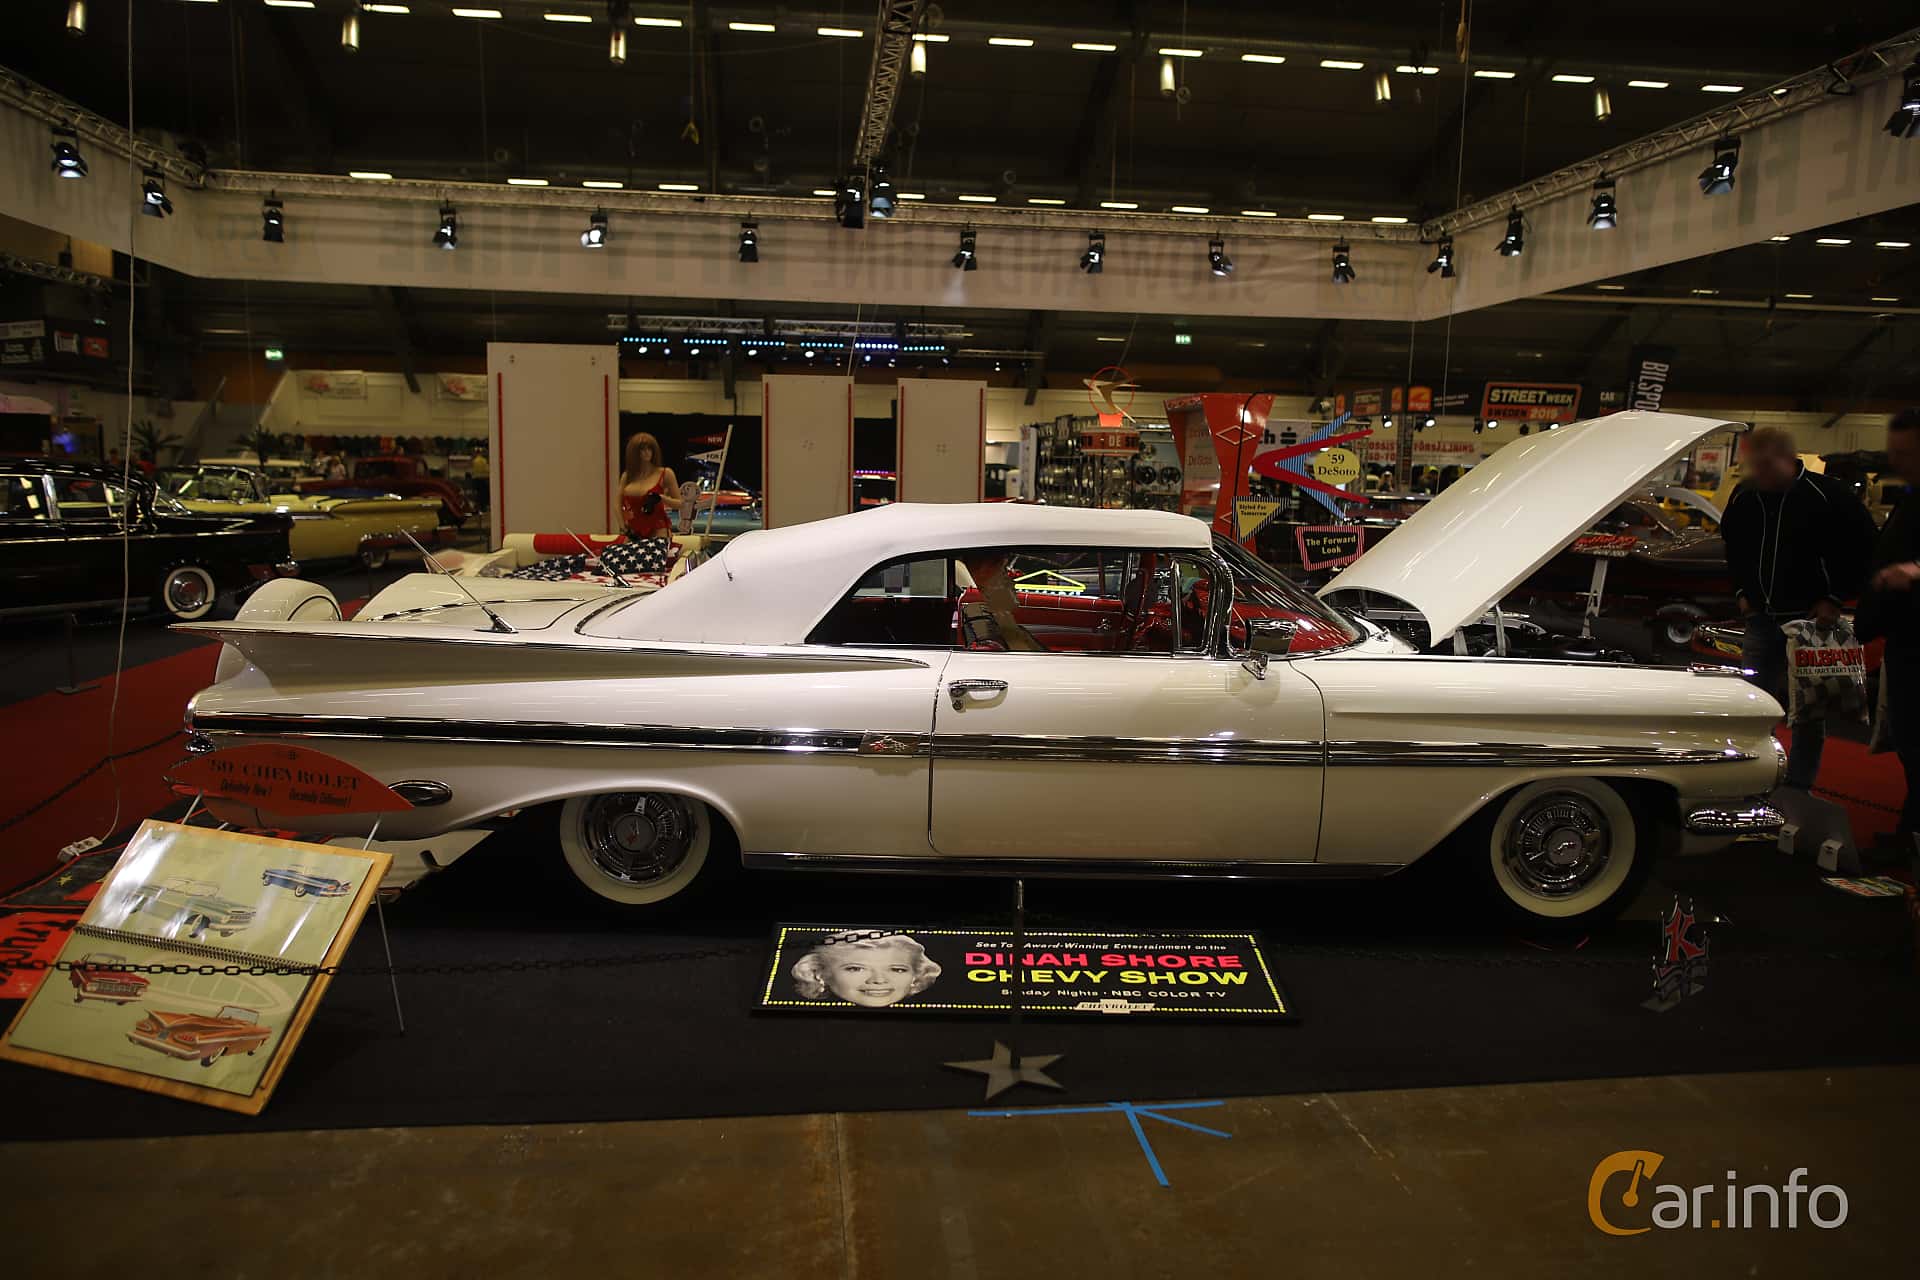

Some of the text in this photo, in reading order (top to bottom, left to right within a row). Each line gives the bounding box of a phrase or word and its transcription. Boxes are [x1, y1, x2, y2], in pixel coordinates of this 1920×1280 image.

[1634, 360, 1670, 412] BILSPO
[1318, 466, 1356, 476] DeSoto
[1305, 535, 1357, 546] The Forward
[1321, 545, 1342, 554] Look
[241, 764, 361, 791] CHEVROLET
[975, 941, 997, 950] See
[1023, 942, 1109, 952] Award-Winning
[1112, 942, 1192, 951] Entertainment
[964, 951, 1244, 969] DINAH SHORE
[967, 968, 1249, 986] CHEVY SHOW
[1057, 988, 1099, 999] Nights
[1111, 989, 1143, 998] NBC
[1147, 990, 1200, 998] COLOR
[1206, 991, 1228, 999] TV
